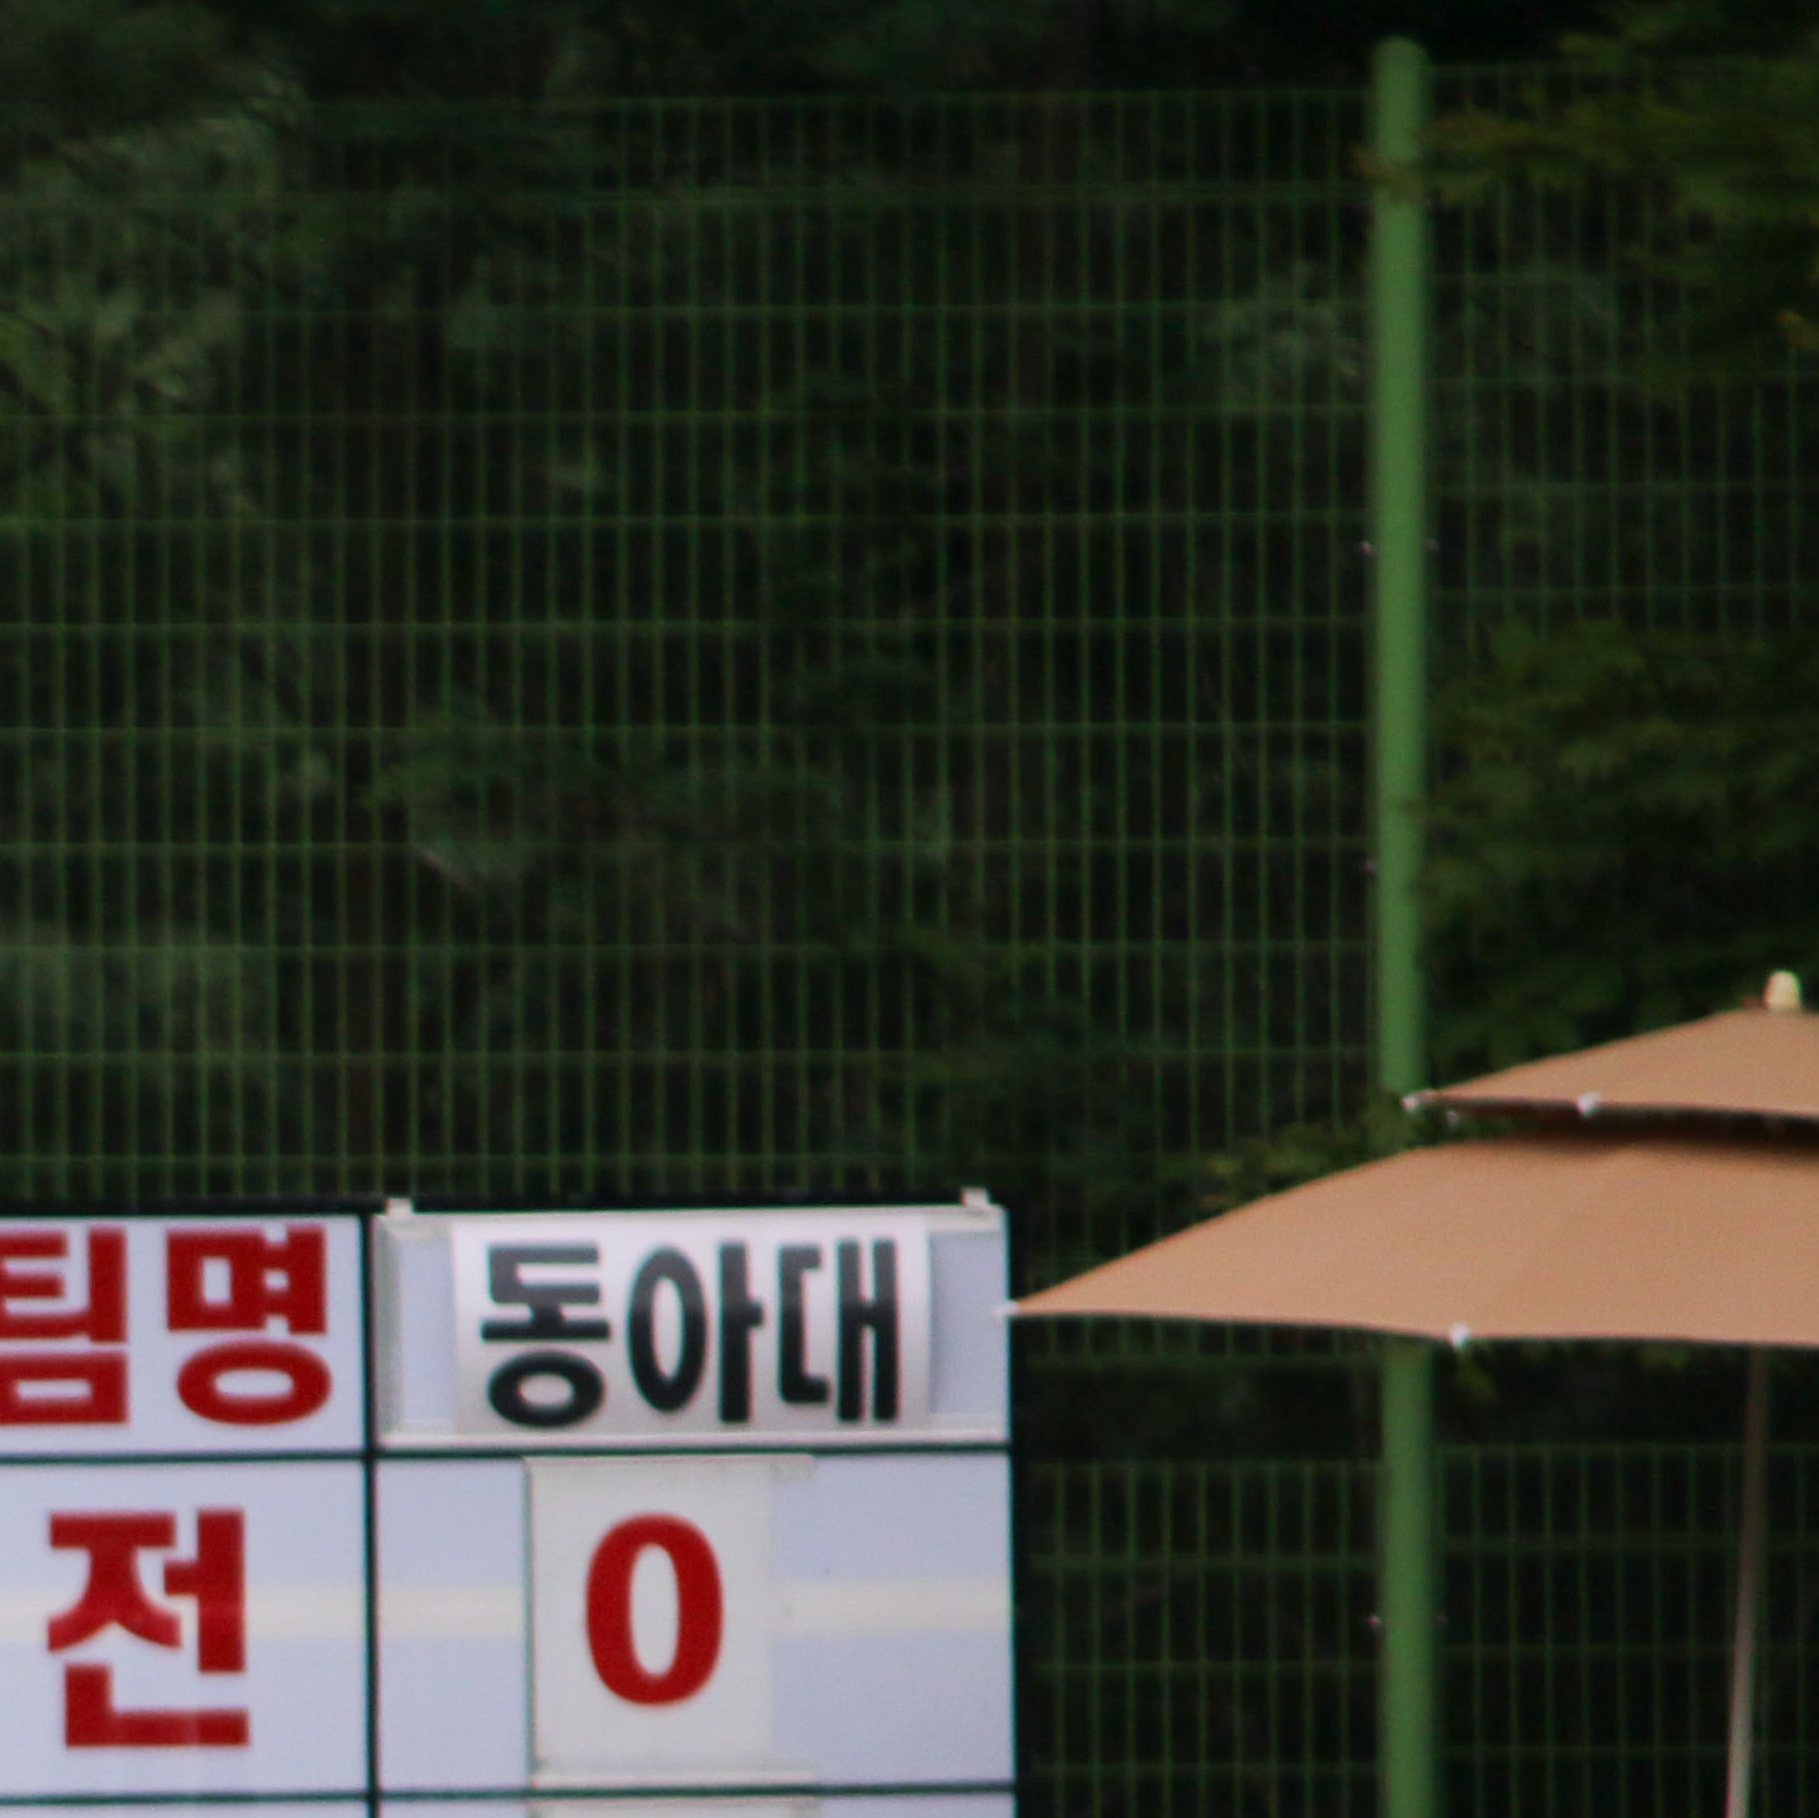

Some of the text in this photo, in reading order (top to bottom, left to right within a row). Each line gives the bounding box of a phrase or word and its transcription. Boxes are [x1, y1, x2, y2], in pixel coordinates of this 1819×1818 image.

[480, 1239, 901, 1429] 동아대
[46, 1509, 251, 1749] 전
[584, 1513, 726, 1708] 0
